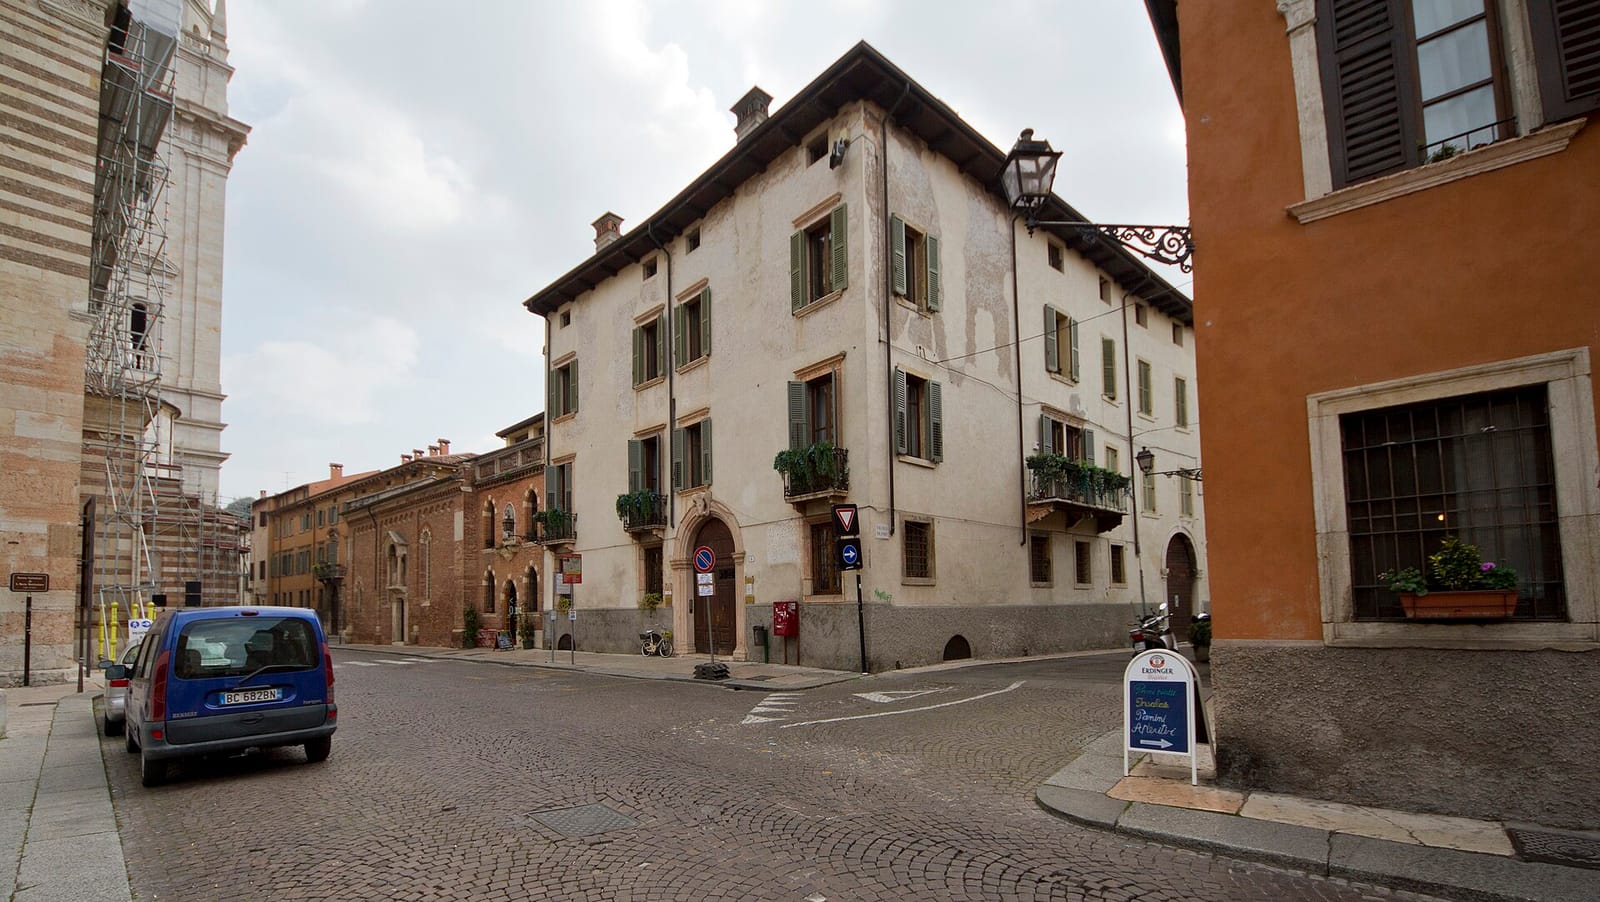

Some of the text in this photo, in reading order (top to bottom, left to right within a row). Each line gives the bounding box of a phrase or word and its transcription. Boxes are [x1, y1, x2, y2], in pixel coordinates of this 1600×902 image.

[226, 690, 276, 703] BC 682BN
[1135, 709, 1167, 722] Panini
